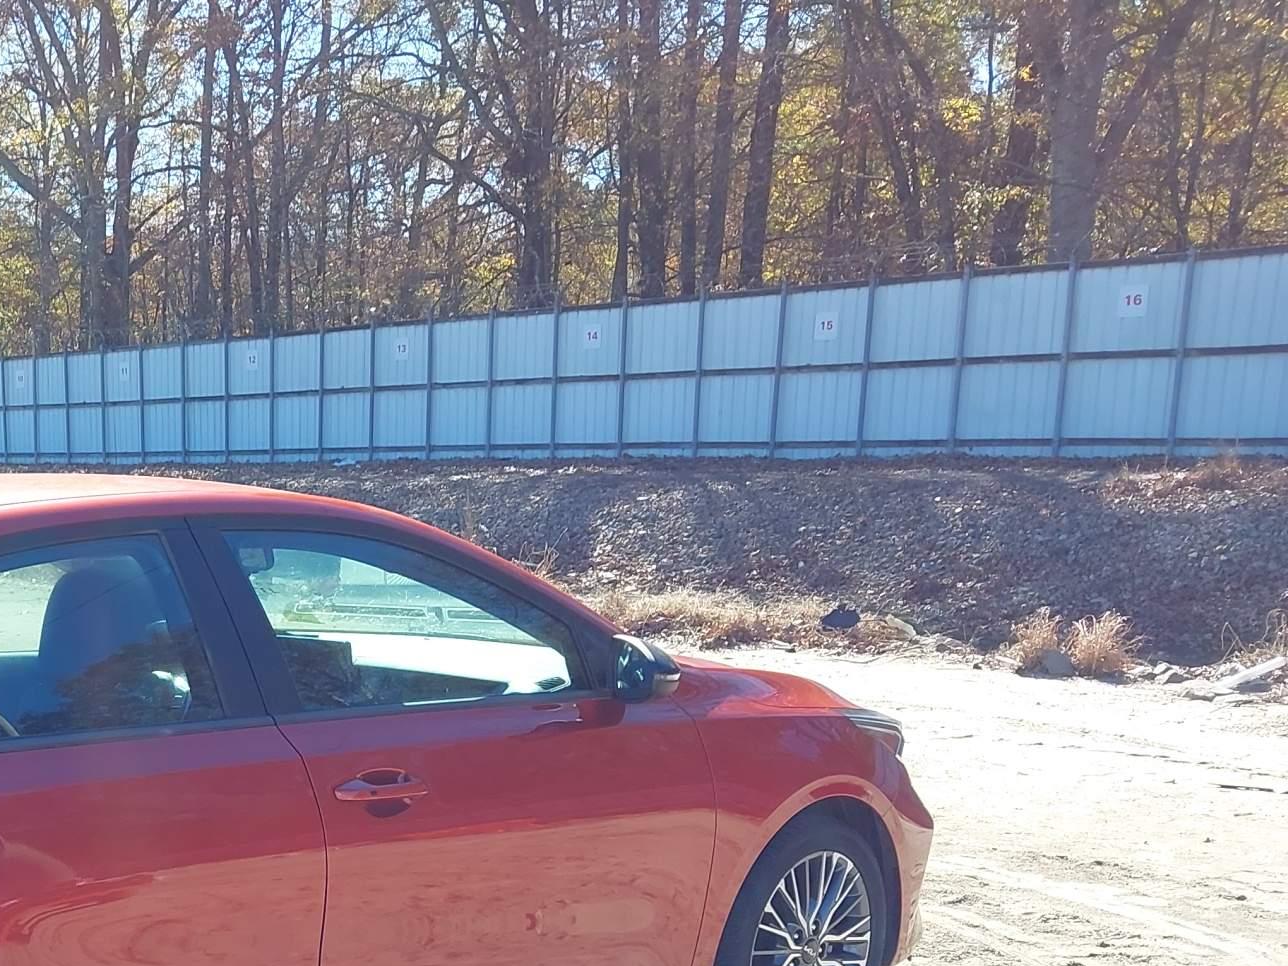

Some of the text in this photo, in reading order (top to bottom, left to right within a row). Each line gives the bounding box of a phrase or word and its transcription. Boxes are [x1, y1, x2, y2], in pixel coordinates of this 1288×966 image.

[1125, 294, 1143, 306] 16
[821, 320, 833, 331] 15
[587, 331, 598, 341] 14
